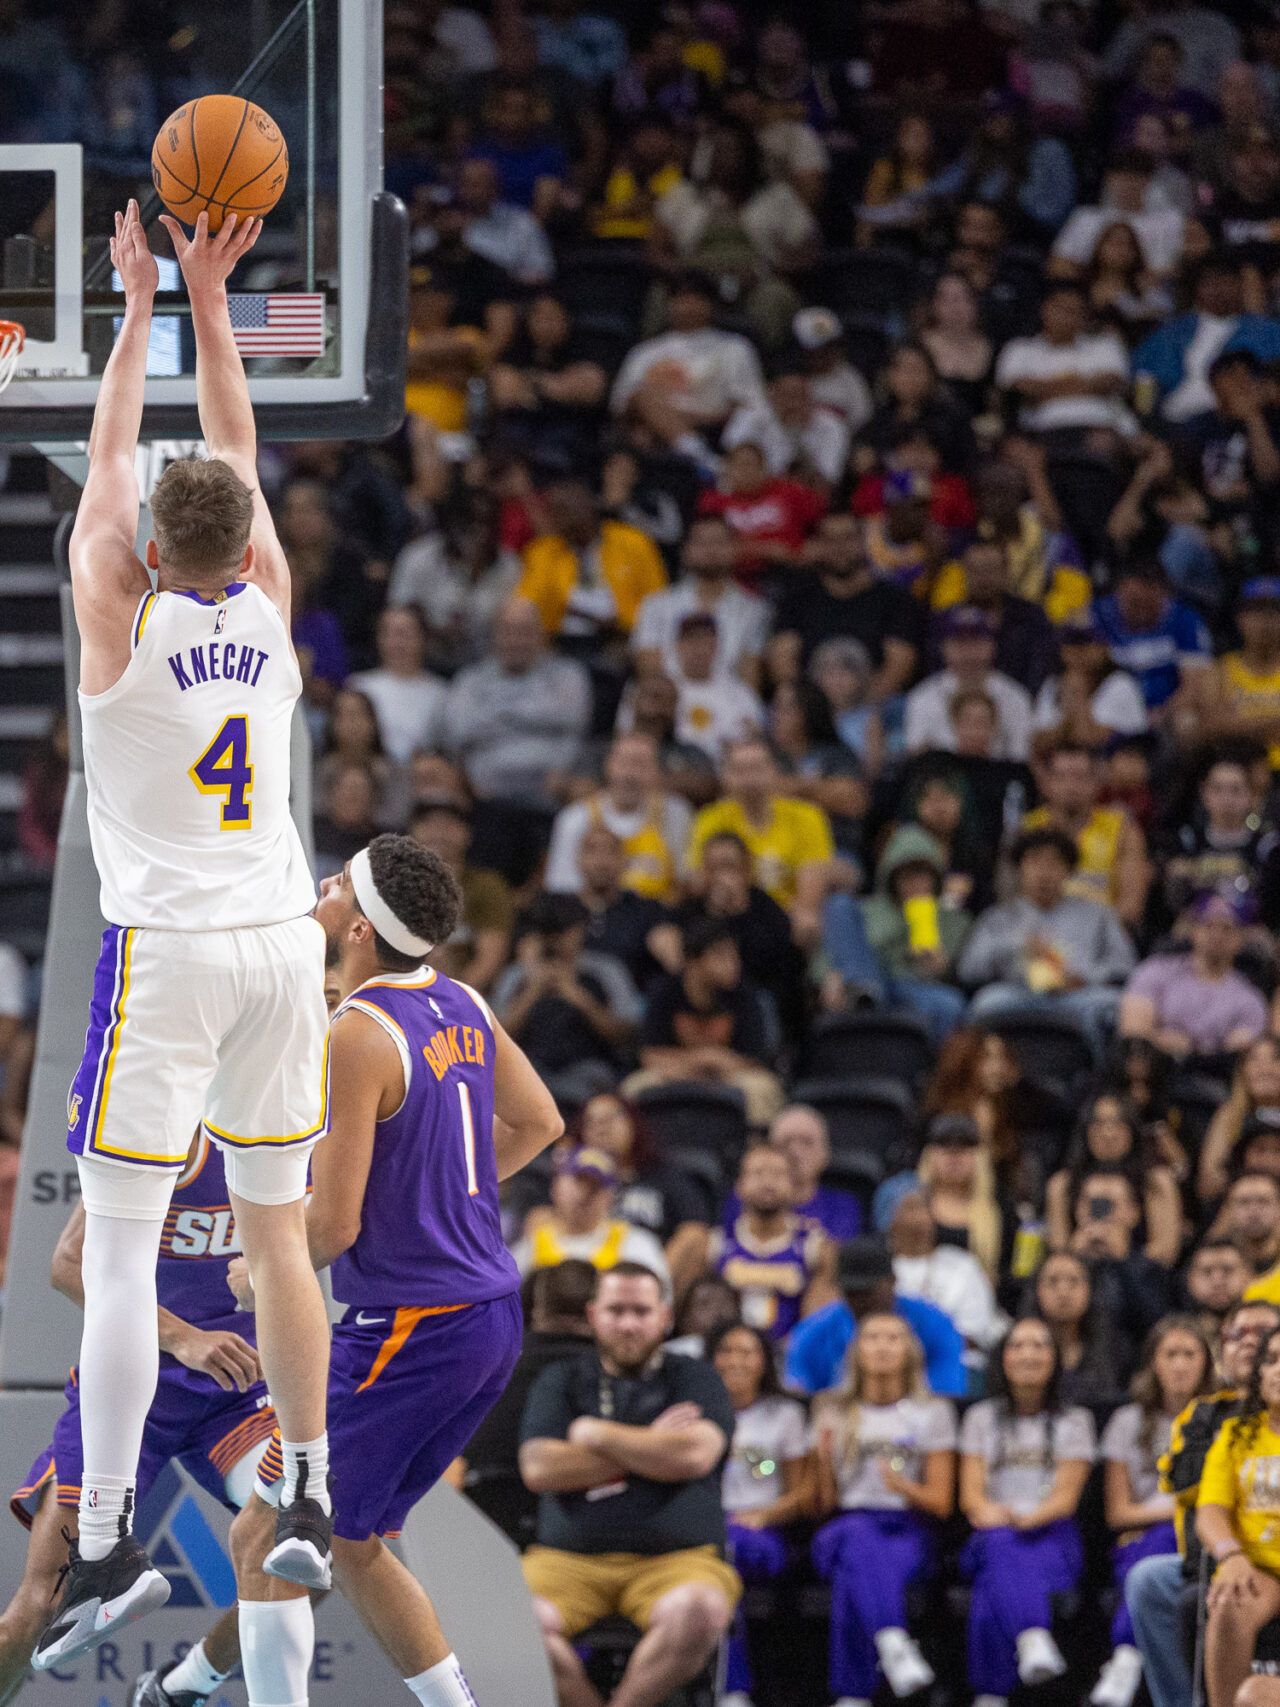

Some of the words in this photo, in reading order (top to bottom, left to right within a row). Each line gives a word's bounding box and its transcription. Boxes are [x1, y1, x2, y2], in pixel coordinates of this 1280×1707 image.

[167, 642, 269, 692] KNECHT
[187, 713, 255, 831] 4
[422, 1025, 486, 1082] BOOKER
[456, 1081, 481, 1197] 1
